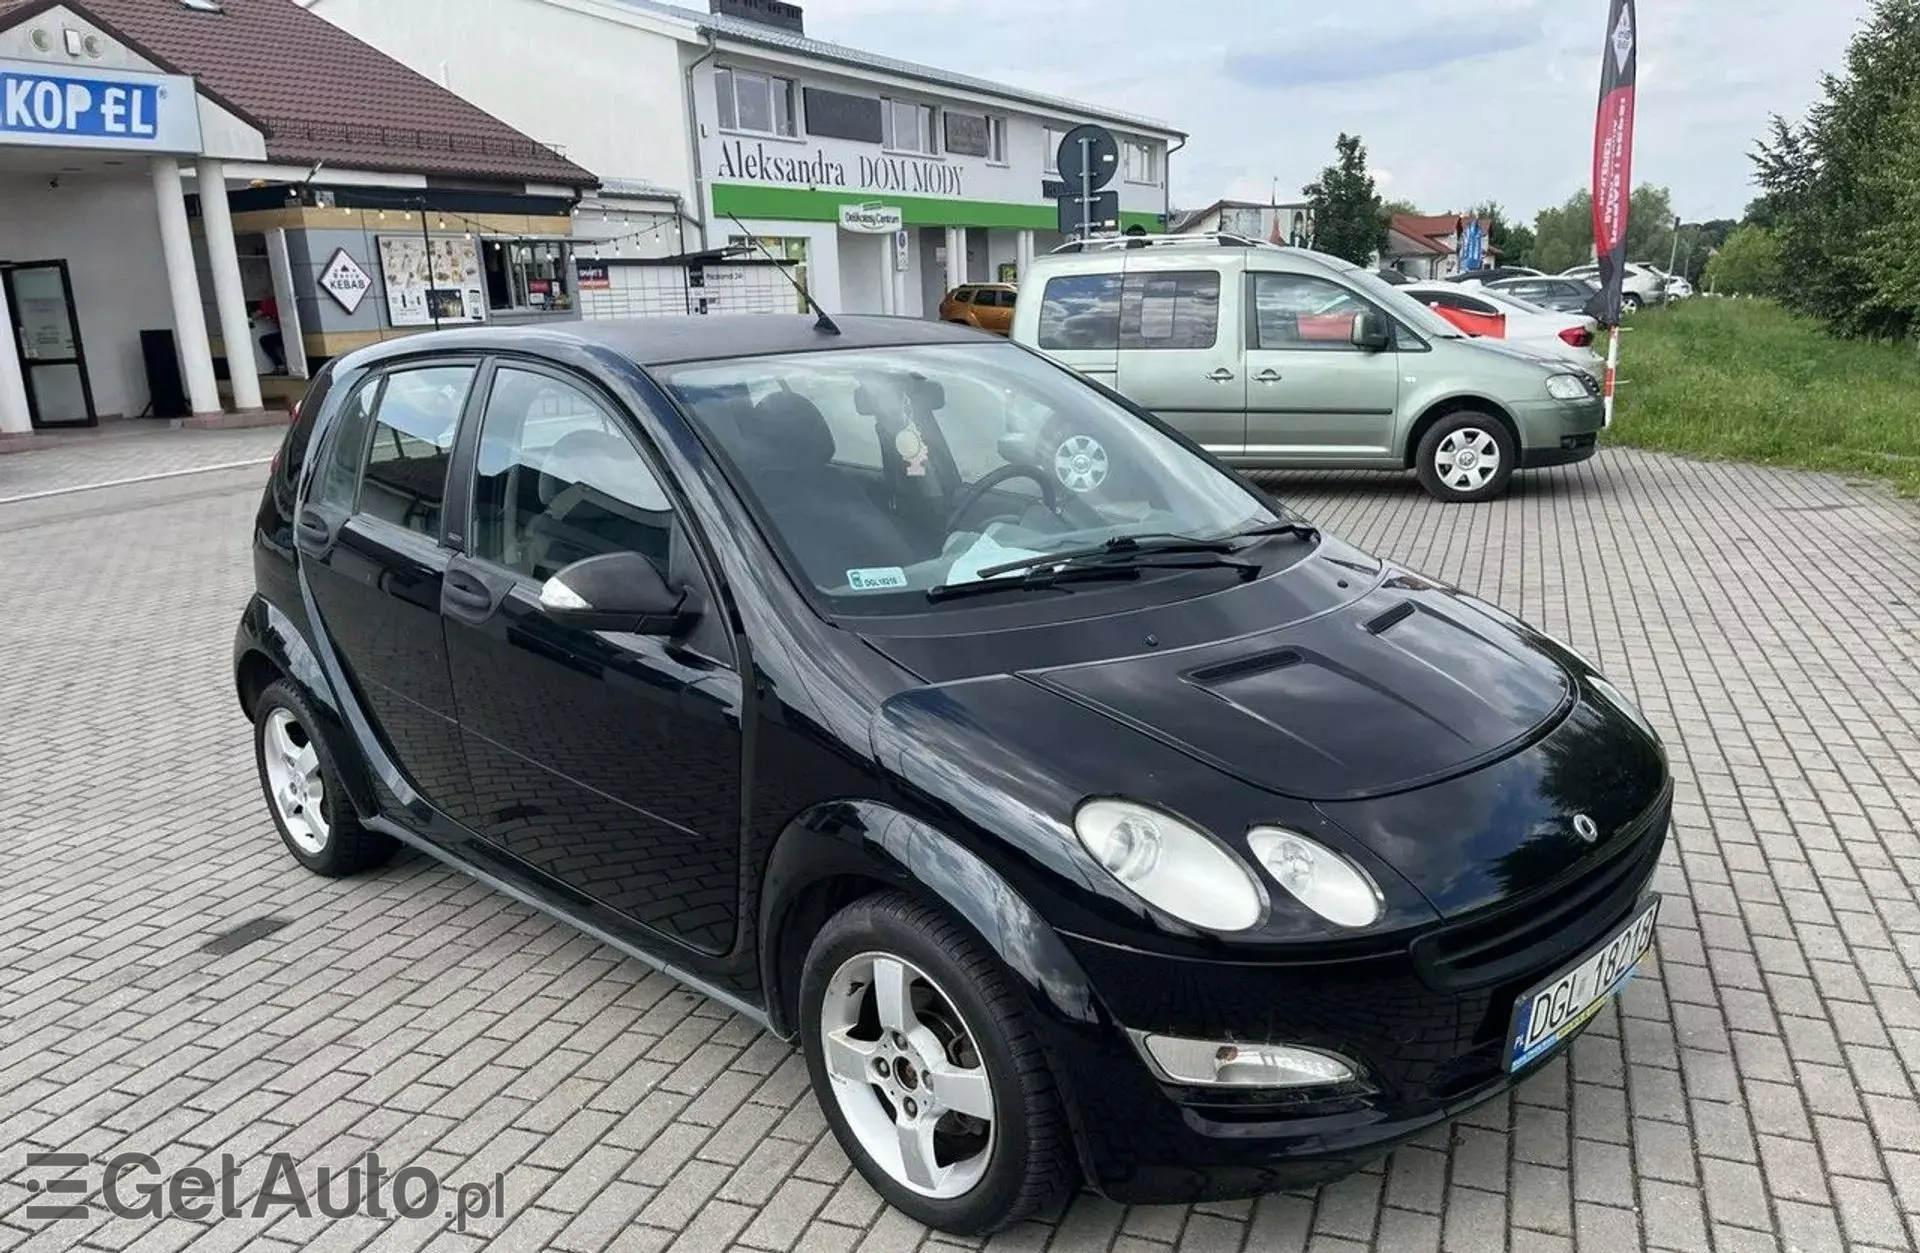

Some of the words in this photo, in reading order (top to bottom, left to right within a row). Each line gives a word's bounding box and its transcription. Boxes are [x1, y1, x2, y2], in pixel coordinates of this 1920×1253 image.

[718, 140, 846, 186] Aleksandra
[859, 155, 908, 192] DOM
[912, 161, 965, 196] MODY
[876, 213, 899, 224] Centrum
[330, 279, 366, 290] KEBAB
[1529, 973, 1579, 1041] DGL
